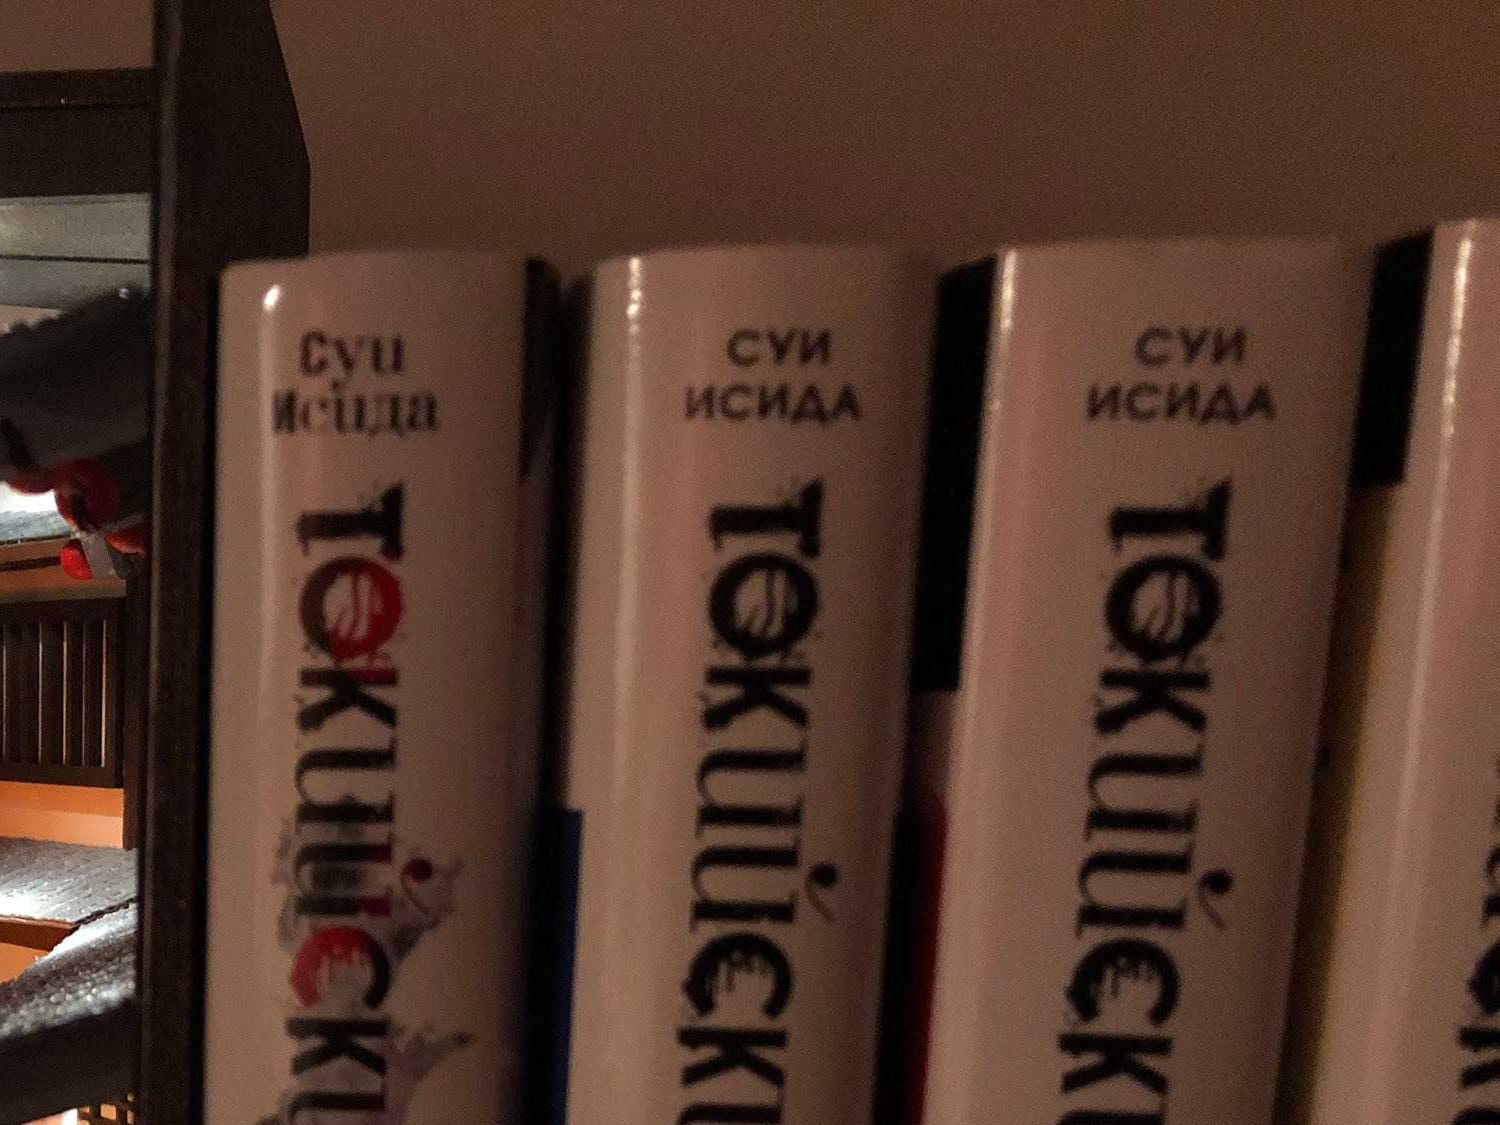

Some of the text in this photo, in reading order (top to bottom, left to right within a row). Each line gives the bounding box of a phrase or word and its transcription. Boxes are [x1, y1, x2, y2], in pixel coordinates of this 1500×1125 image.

[727, 328, 835, 368] СУИ
[1133, 326, 1248, 367] СУИ
[684, 383, 863, 424] ИСИДА
[1086, 382, 1277, 425] ИСИДА
